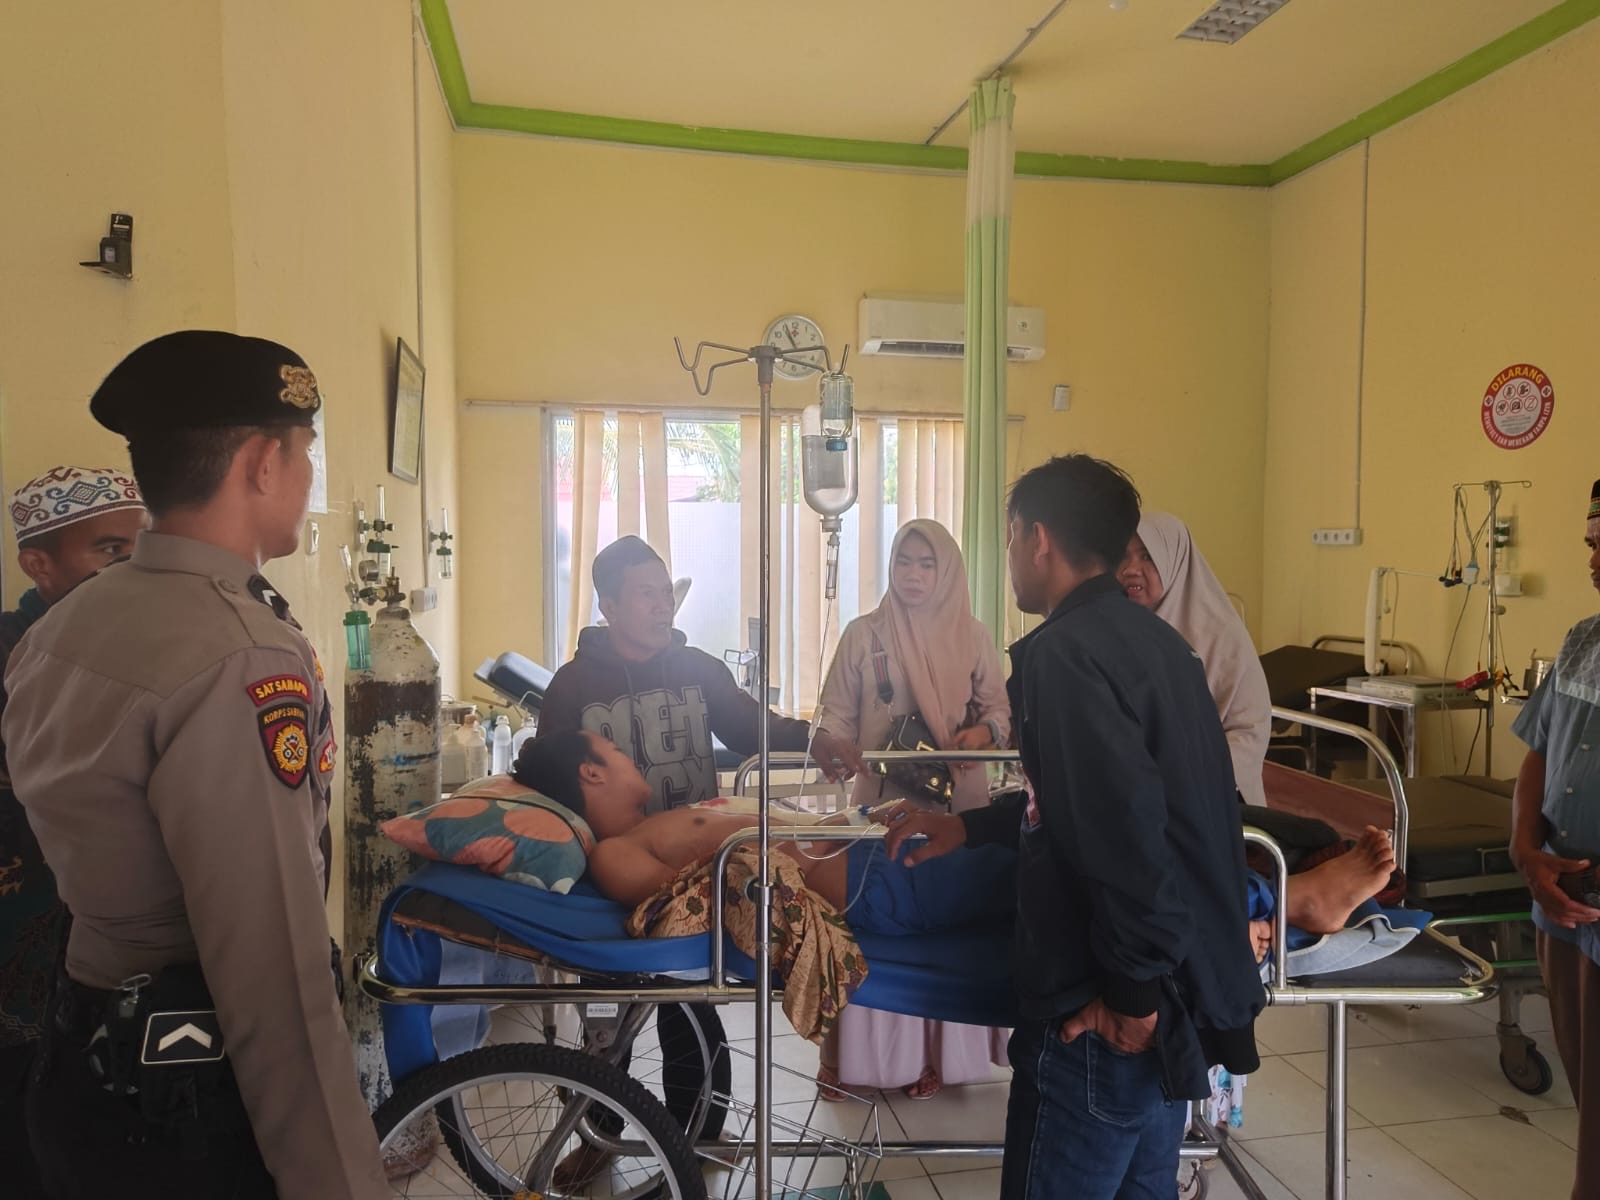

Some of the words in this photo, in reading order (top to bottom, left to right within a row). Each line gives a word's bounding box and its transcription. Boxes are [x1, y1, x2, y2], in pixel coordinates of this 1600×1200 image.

[1491, 367, 1544, 391] DILARANG
[256, 682, 274, 698] SAT
[263, 708, 286, 725] KORPS
